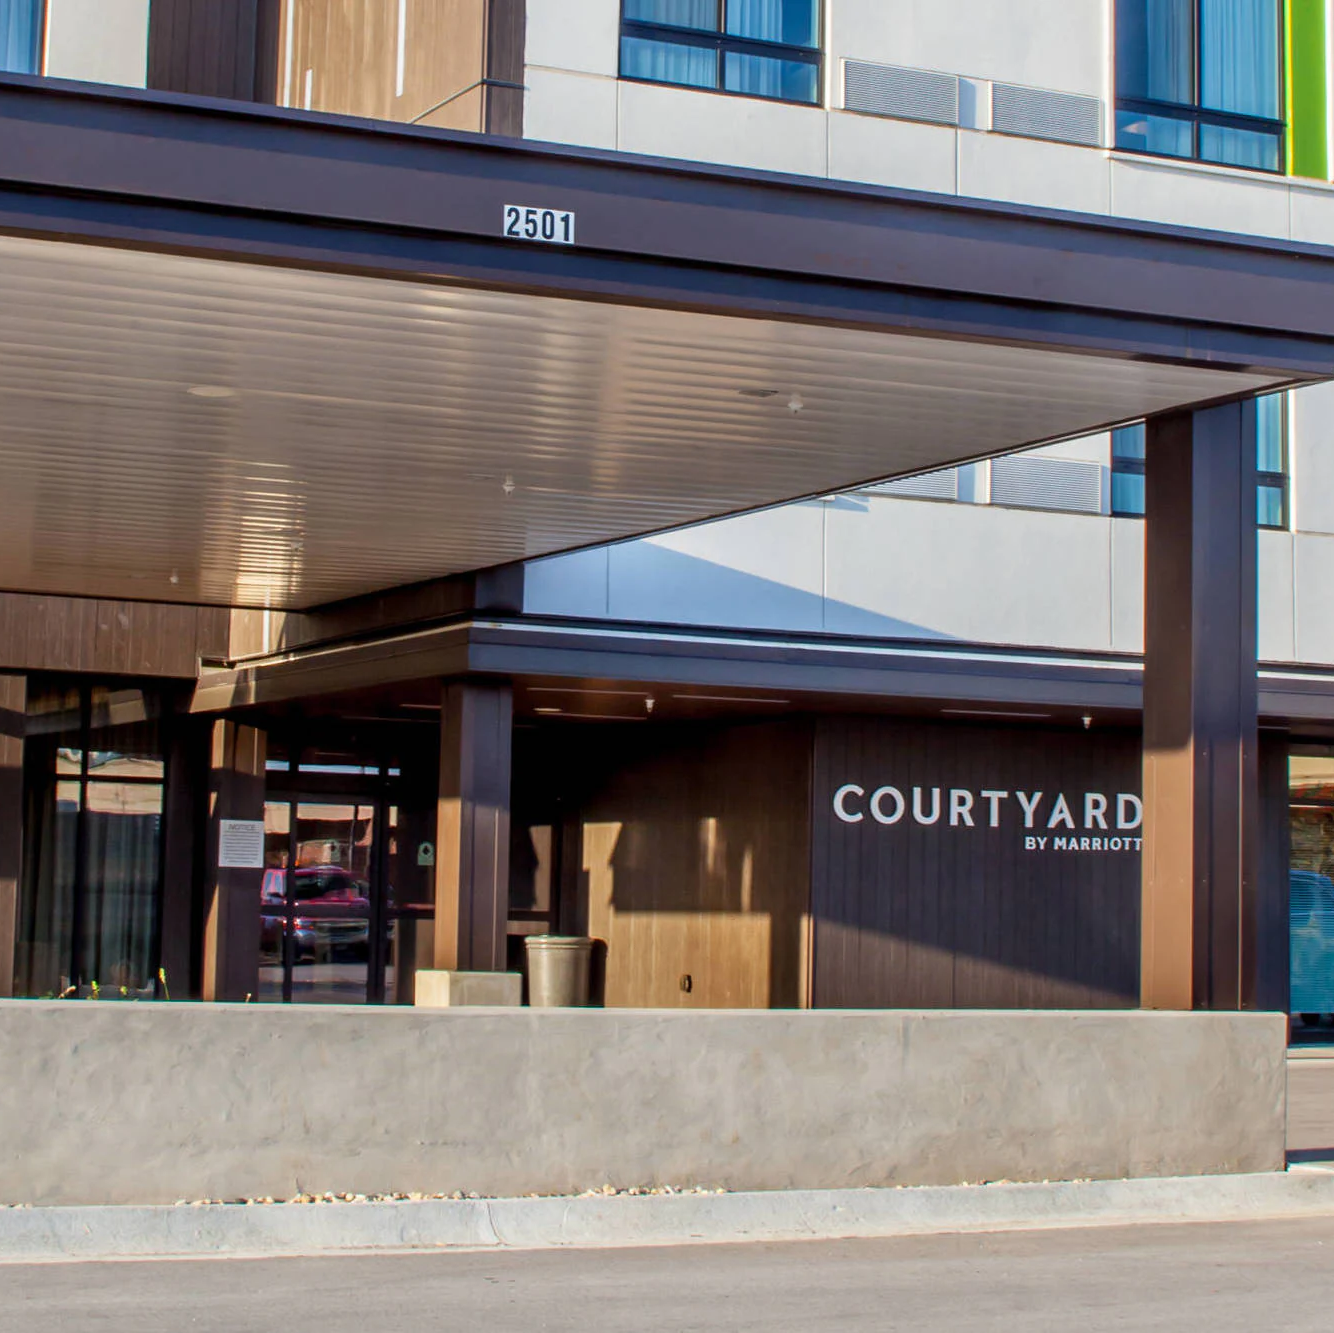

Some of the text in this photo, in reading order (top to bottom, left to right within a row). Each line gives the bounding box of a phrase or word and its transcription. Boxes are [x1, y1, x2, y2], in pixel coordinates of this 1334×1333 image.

[506, 207, 570, 242] 2501
[833, 784, 1143, 830] COURTYARD
[1024, 836, 1142, 852] BY MARRIOTT
